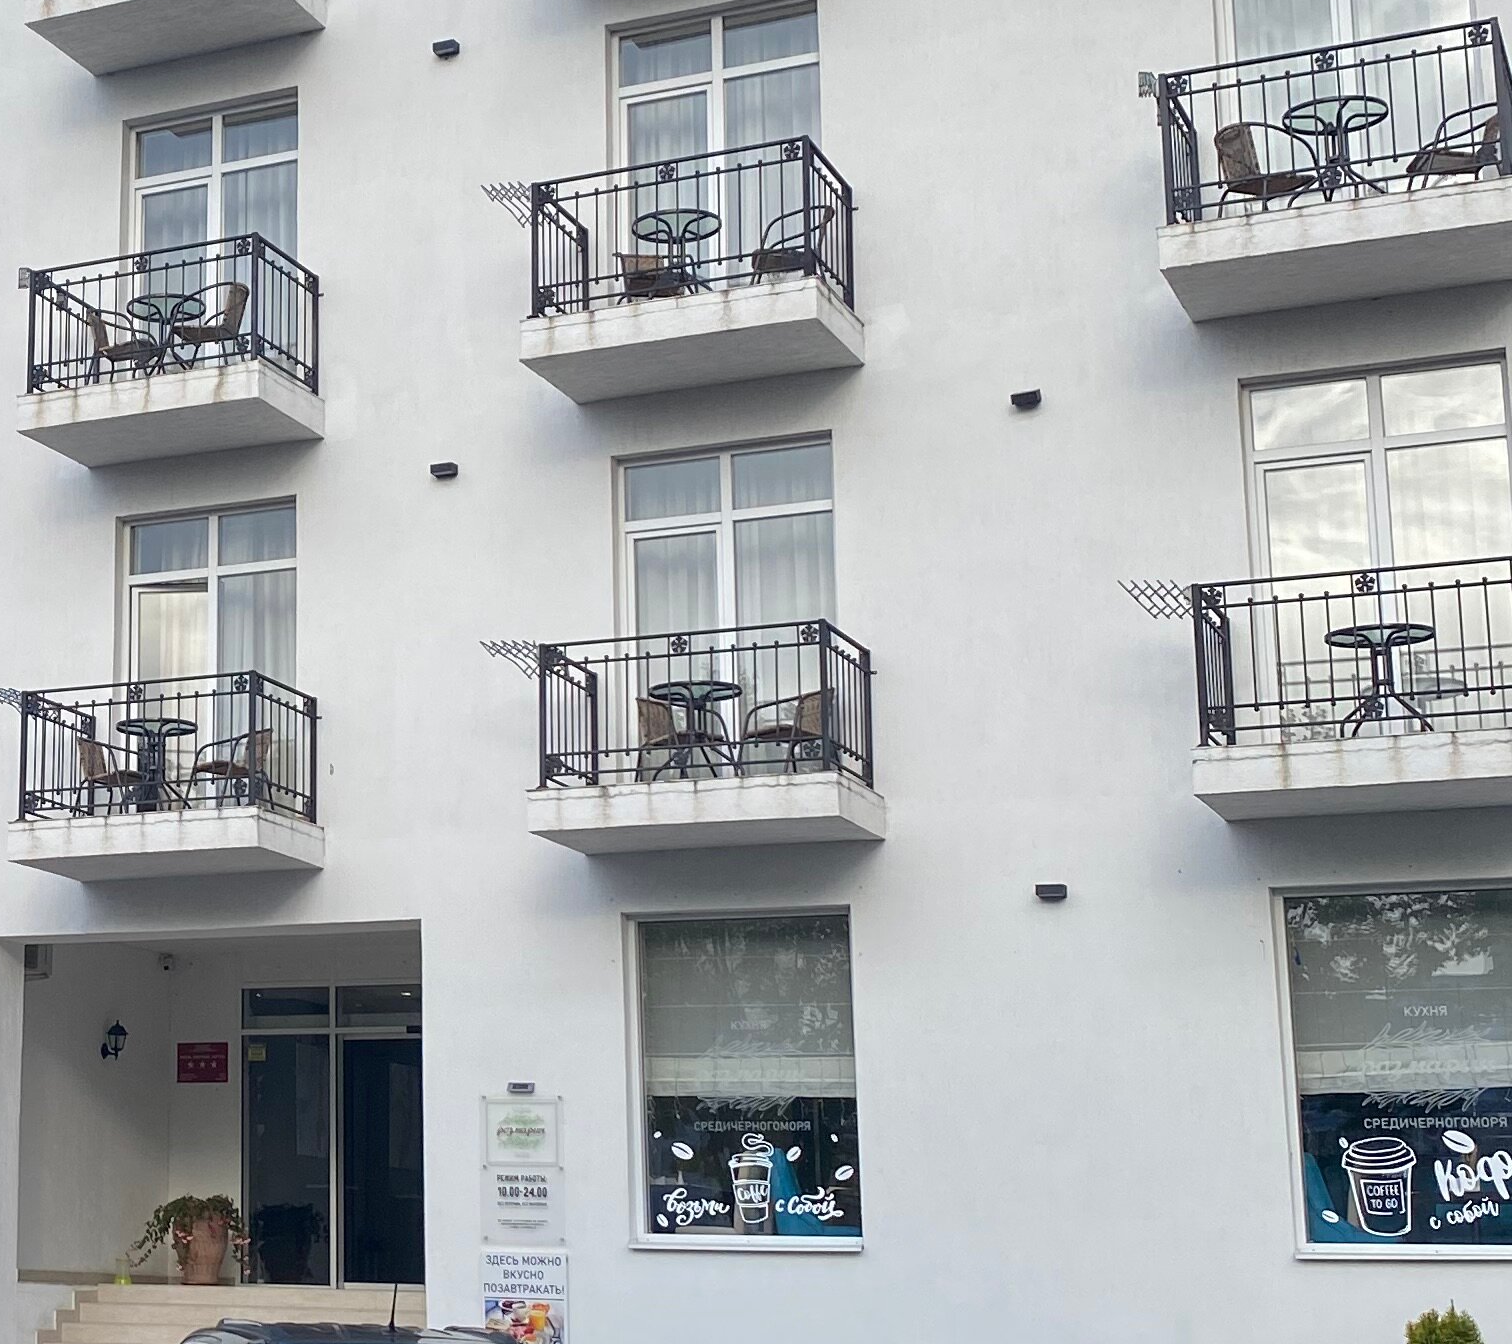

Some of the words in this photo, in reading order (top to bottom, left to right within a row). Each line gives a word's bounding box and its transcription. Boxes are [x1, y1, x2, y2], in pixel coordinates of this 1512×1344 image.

[1403, 1006, 1449, 1017] КУХНЯ
[693, 1120, 812, 1132] СРЕДИЧЕРНОГОМОРЯ
[1363, 1116, 1508, 1130] СРЕДИЧЕРНОГОМОРЯ
[1366, 1184, 1400, 1196] COFFEE
[1370, 1199, 1383, 1209] TO
[1386, 1198, 1399, 1209] GO
[485, 1254, 519, 1266] ЗДЕСЬ
[522, 1256, 562, 1266] МОЖНО
[503, 1269, 545, 1279] ВКУСНО
[483, 1282, 565, 1295] ПОЗАВТРАКАТЬ!
